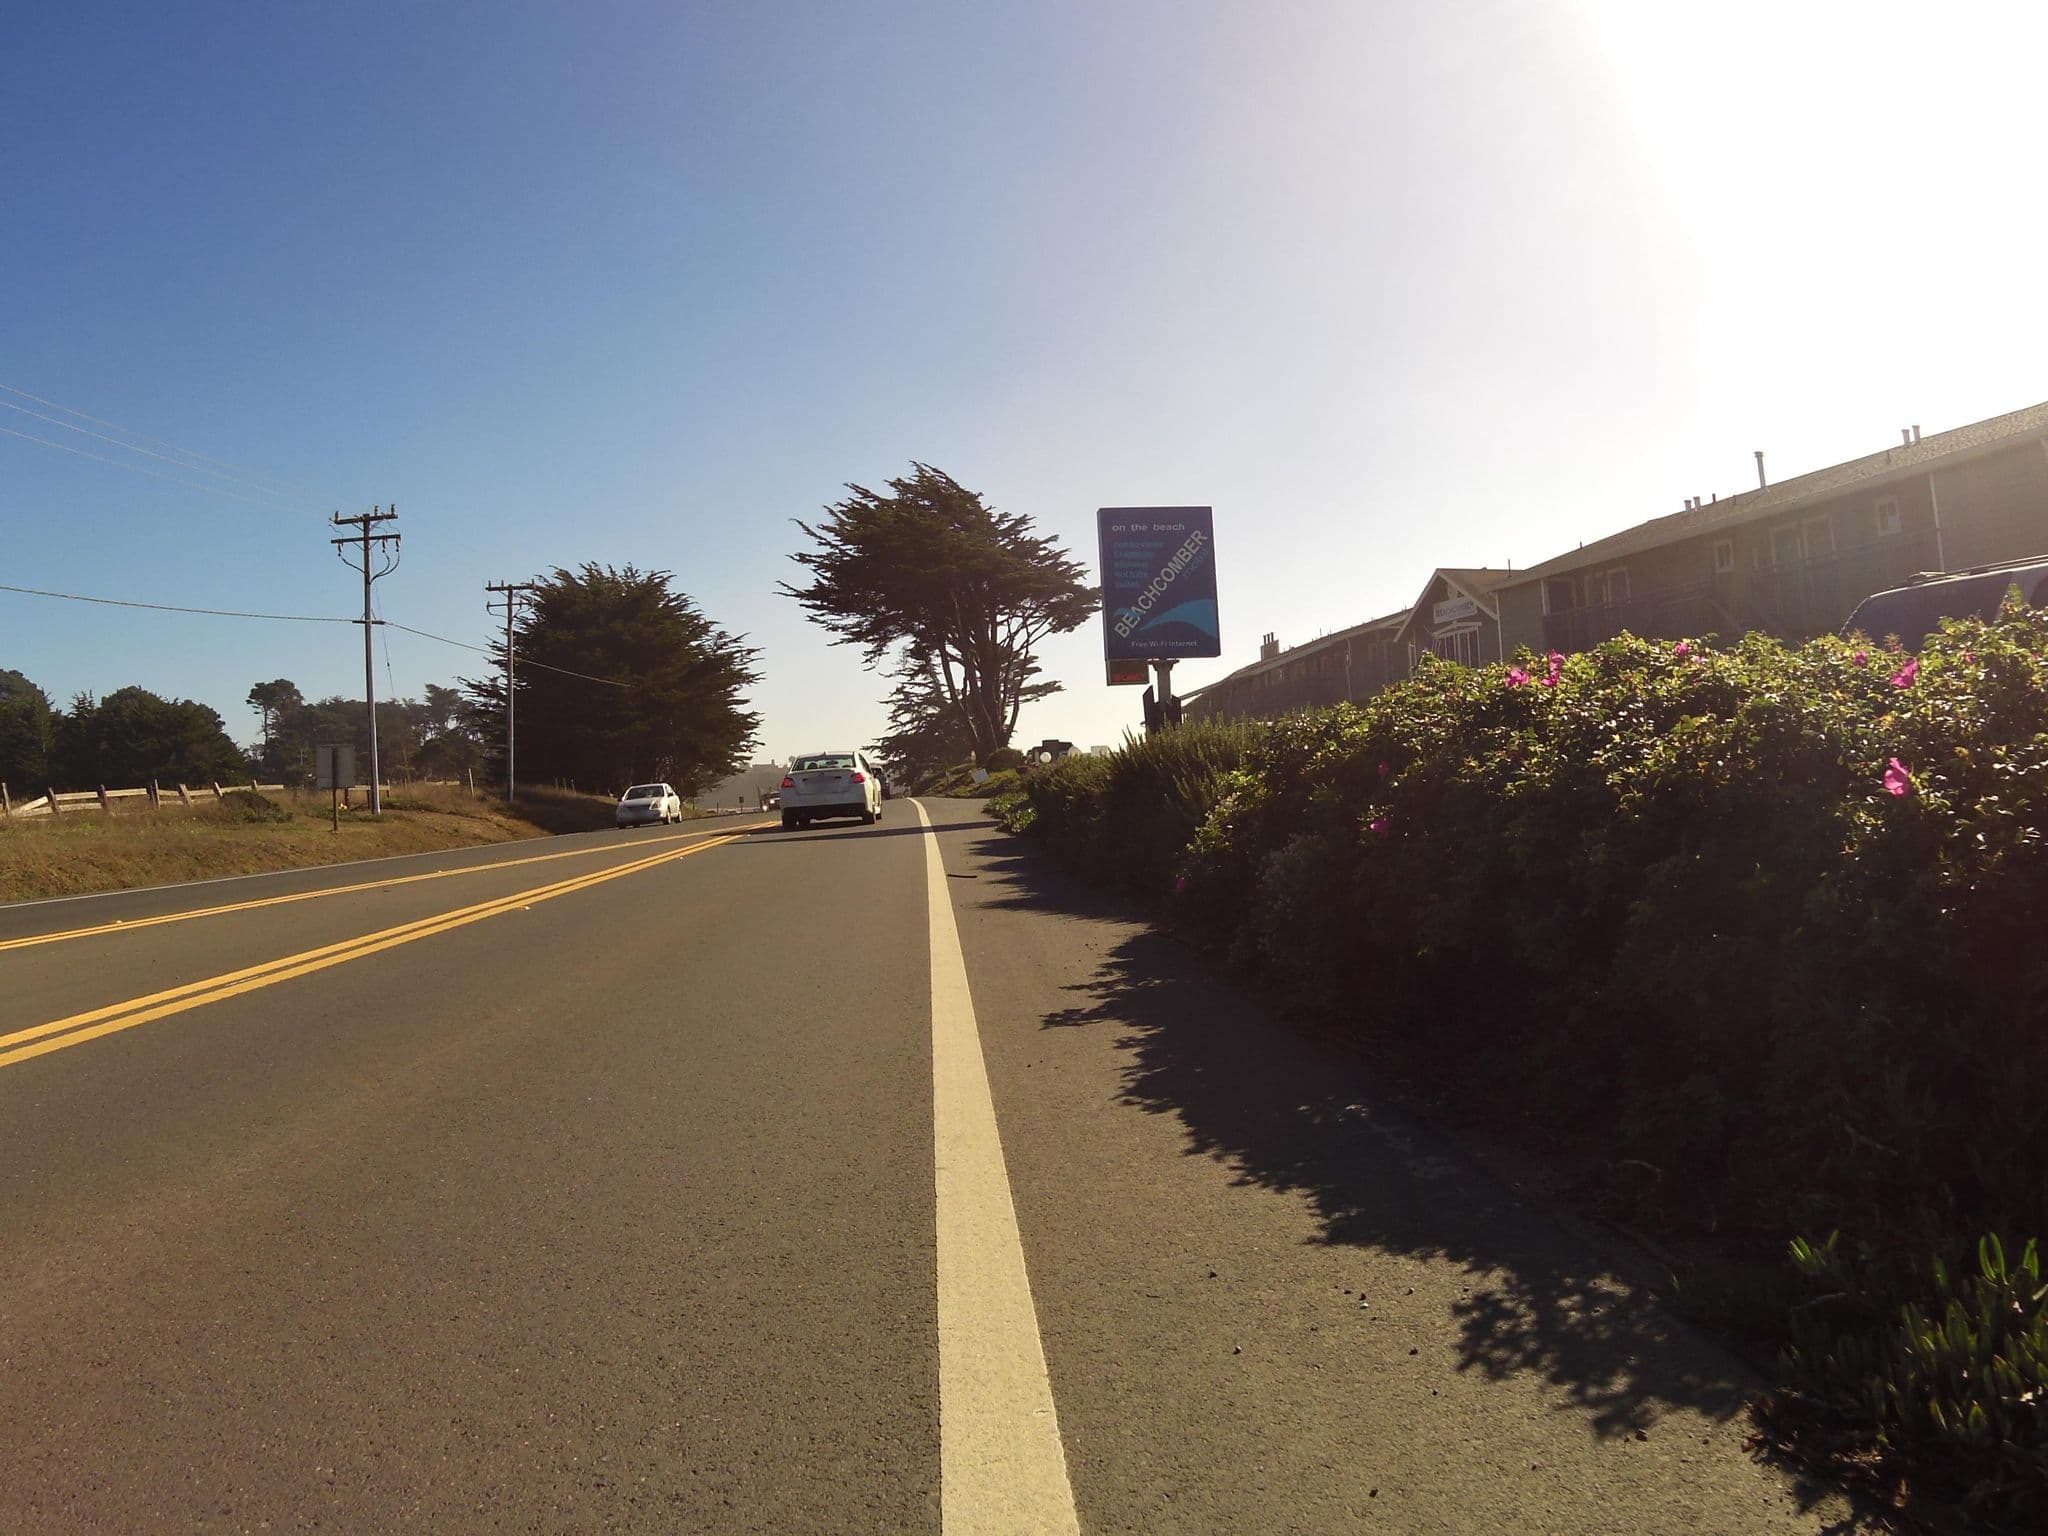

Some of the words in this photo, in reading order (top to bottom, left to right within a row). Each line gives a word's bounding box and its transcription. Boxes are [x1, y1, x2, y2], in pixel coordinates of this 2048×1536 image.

[1112, 524, 1126, 532] on
[1131, 523, 1148, 531] the
[1153, 523, 1185, 531] beach
[1113, 530, 1208, 639] BEACHCOMBER
